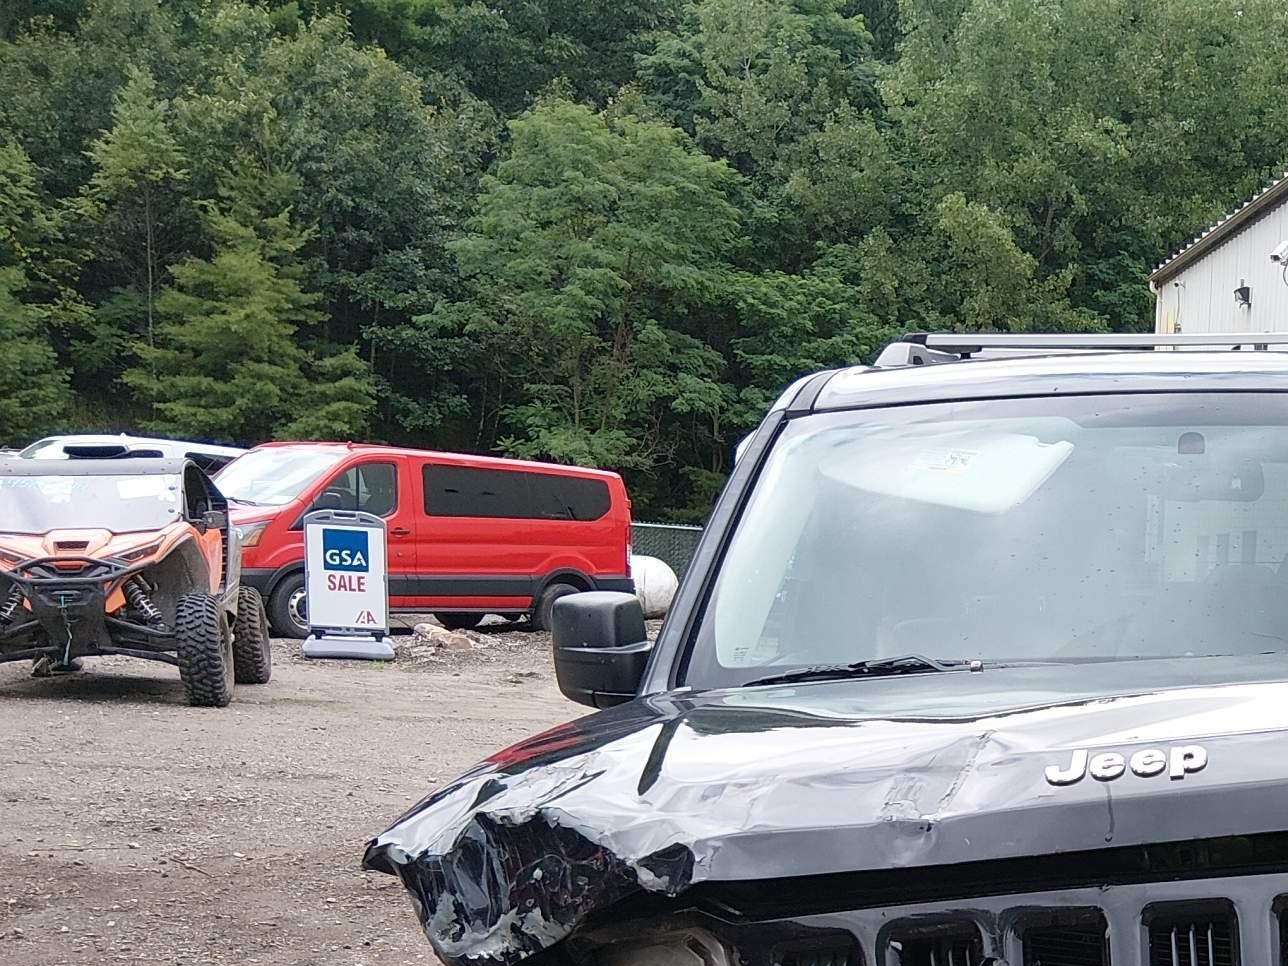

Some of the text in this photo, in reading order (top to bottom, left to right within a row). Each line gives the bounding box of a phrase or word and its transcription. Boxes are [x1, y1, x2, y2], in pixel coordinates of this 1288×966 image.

[325, 549, 367, 567] GSA
[327, 573, 366, 593] SALE
[1044, 745, 1208, 787] Jeep
